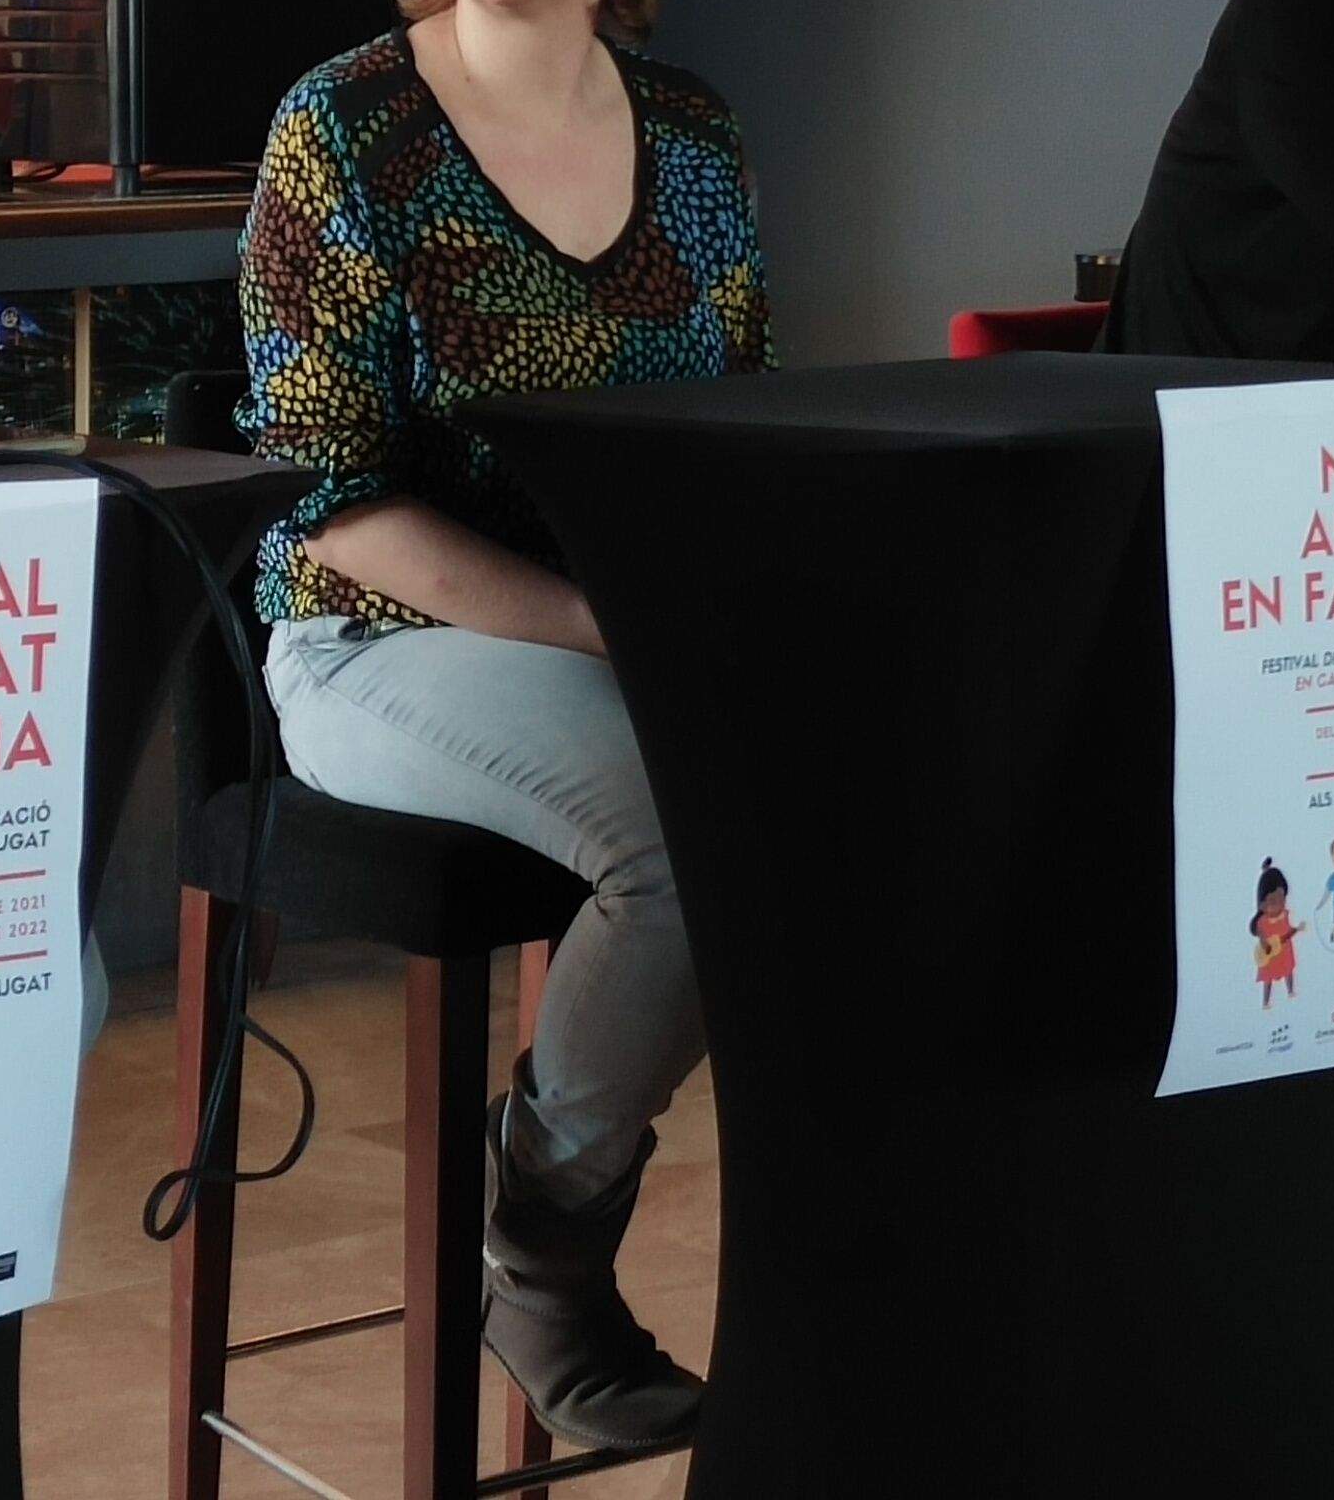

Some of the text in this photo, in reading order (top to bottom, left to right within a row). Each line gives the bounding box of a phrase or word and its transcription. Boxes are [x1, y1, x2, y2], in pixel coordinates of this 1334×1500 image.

[1222, 575, 1282, 632] EN
[1262, 653, 1320, 675] FESTIVAL
[1295, 675, 1313, 692] EN
[1309, 792, 1333, 810] ALS
[11, 894, 47, 914] 2021
[9, 920, 48, 938] 2022
